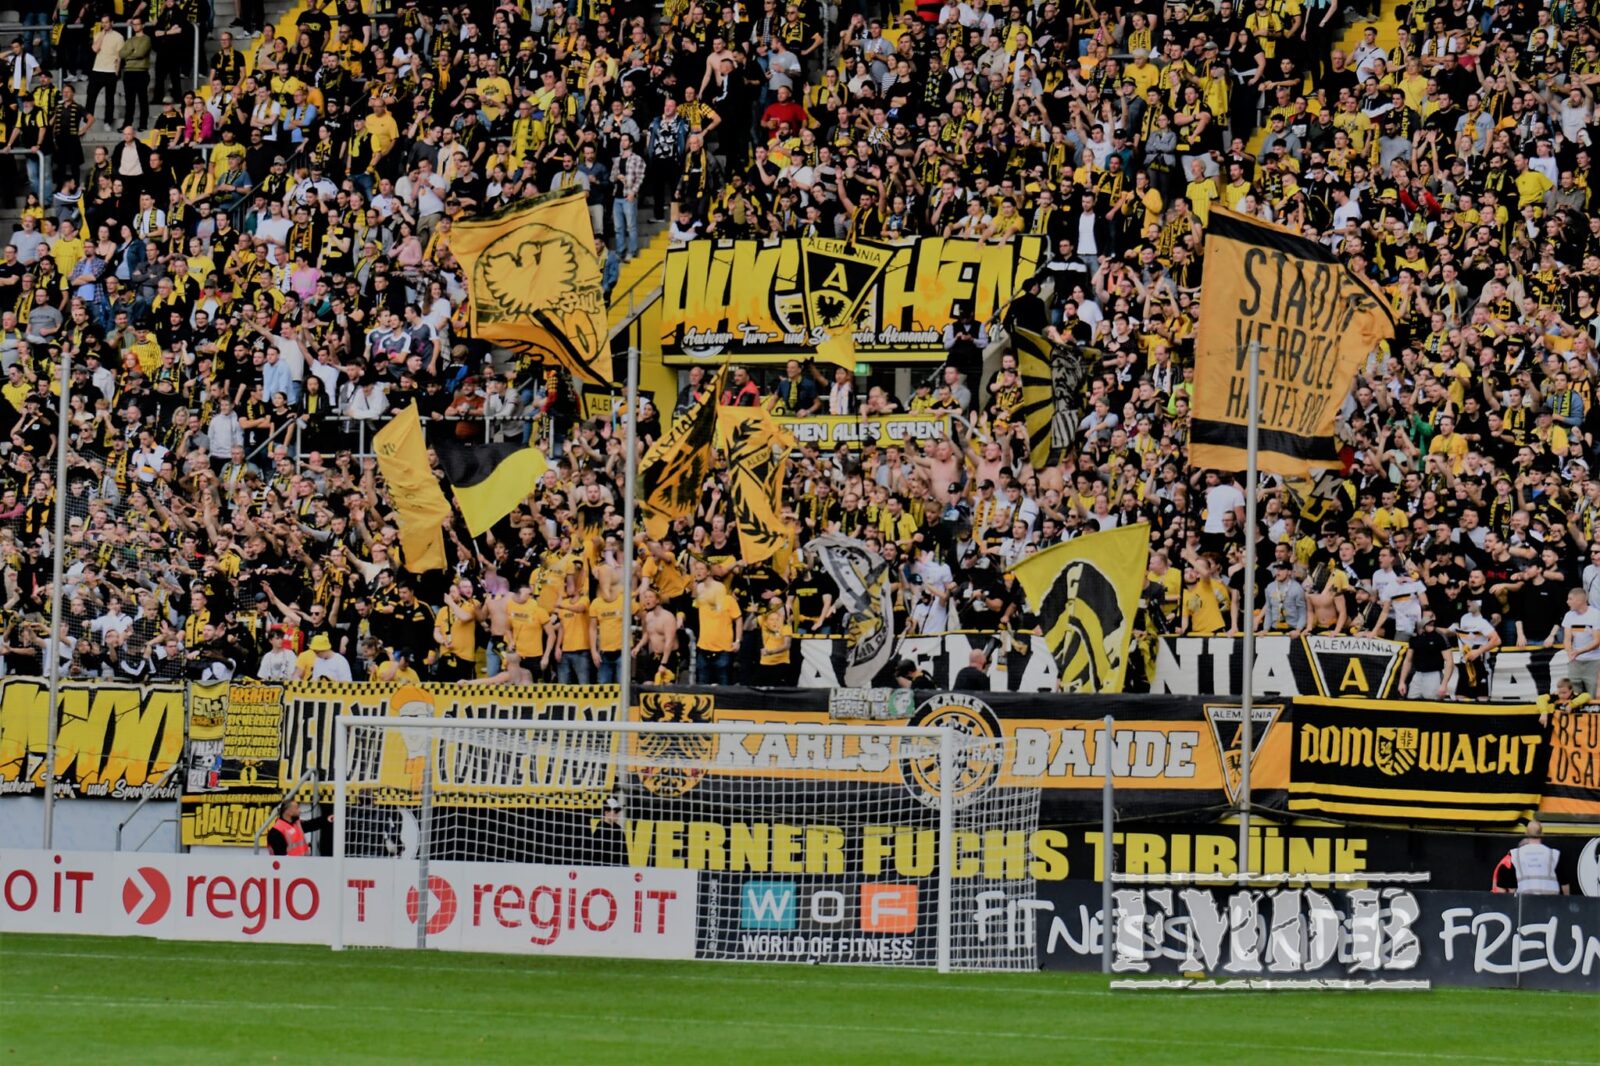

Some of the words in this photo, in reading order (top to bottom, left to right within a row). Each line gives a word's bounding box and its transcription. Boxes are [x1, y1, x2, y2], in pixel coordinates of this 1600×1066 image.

[807, 237, 881, 262] ALEMNNIA
[822, 262, 848, 292] A
[878, 325, 940, 344] Alemannia
[832, 422, 881, 441] ALLES
[1313, 639, 1394, 654] ALEMANNIA
[1339, 657, 1370, 692] A
[1213, 709, 1273, 720] ALEMNNIA
[716, 719, 892, 772] KARLS
[1011, 727, 1199, 778] BANDE
[1418, 730, 1543, 774] WACHT
[862, 825, 1069, 881] FUCHS
[1085, 827, 1368, 889] TRIBÜNE
[186, 860, 320, 935] regio
[473, 871, 618, 946] regio
[633, 872, 677, 934] iT
[742, 934, 805, 955] WORLD
[810, 937, 833, 956] OF
[838, 937, 913, 960] FITNESS
